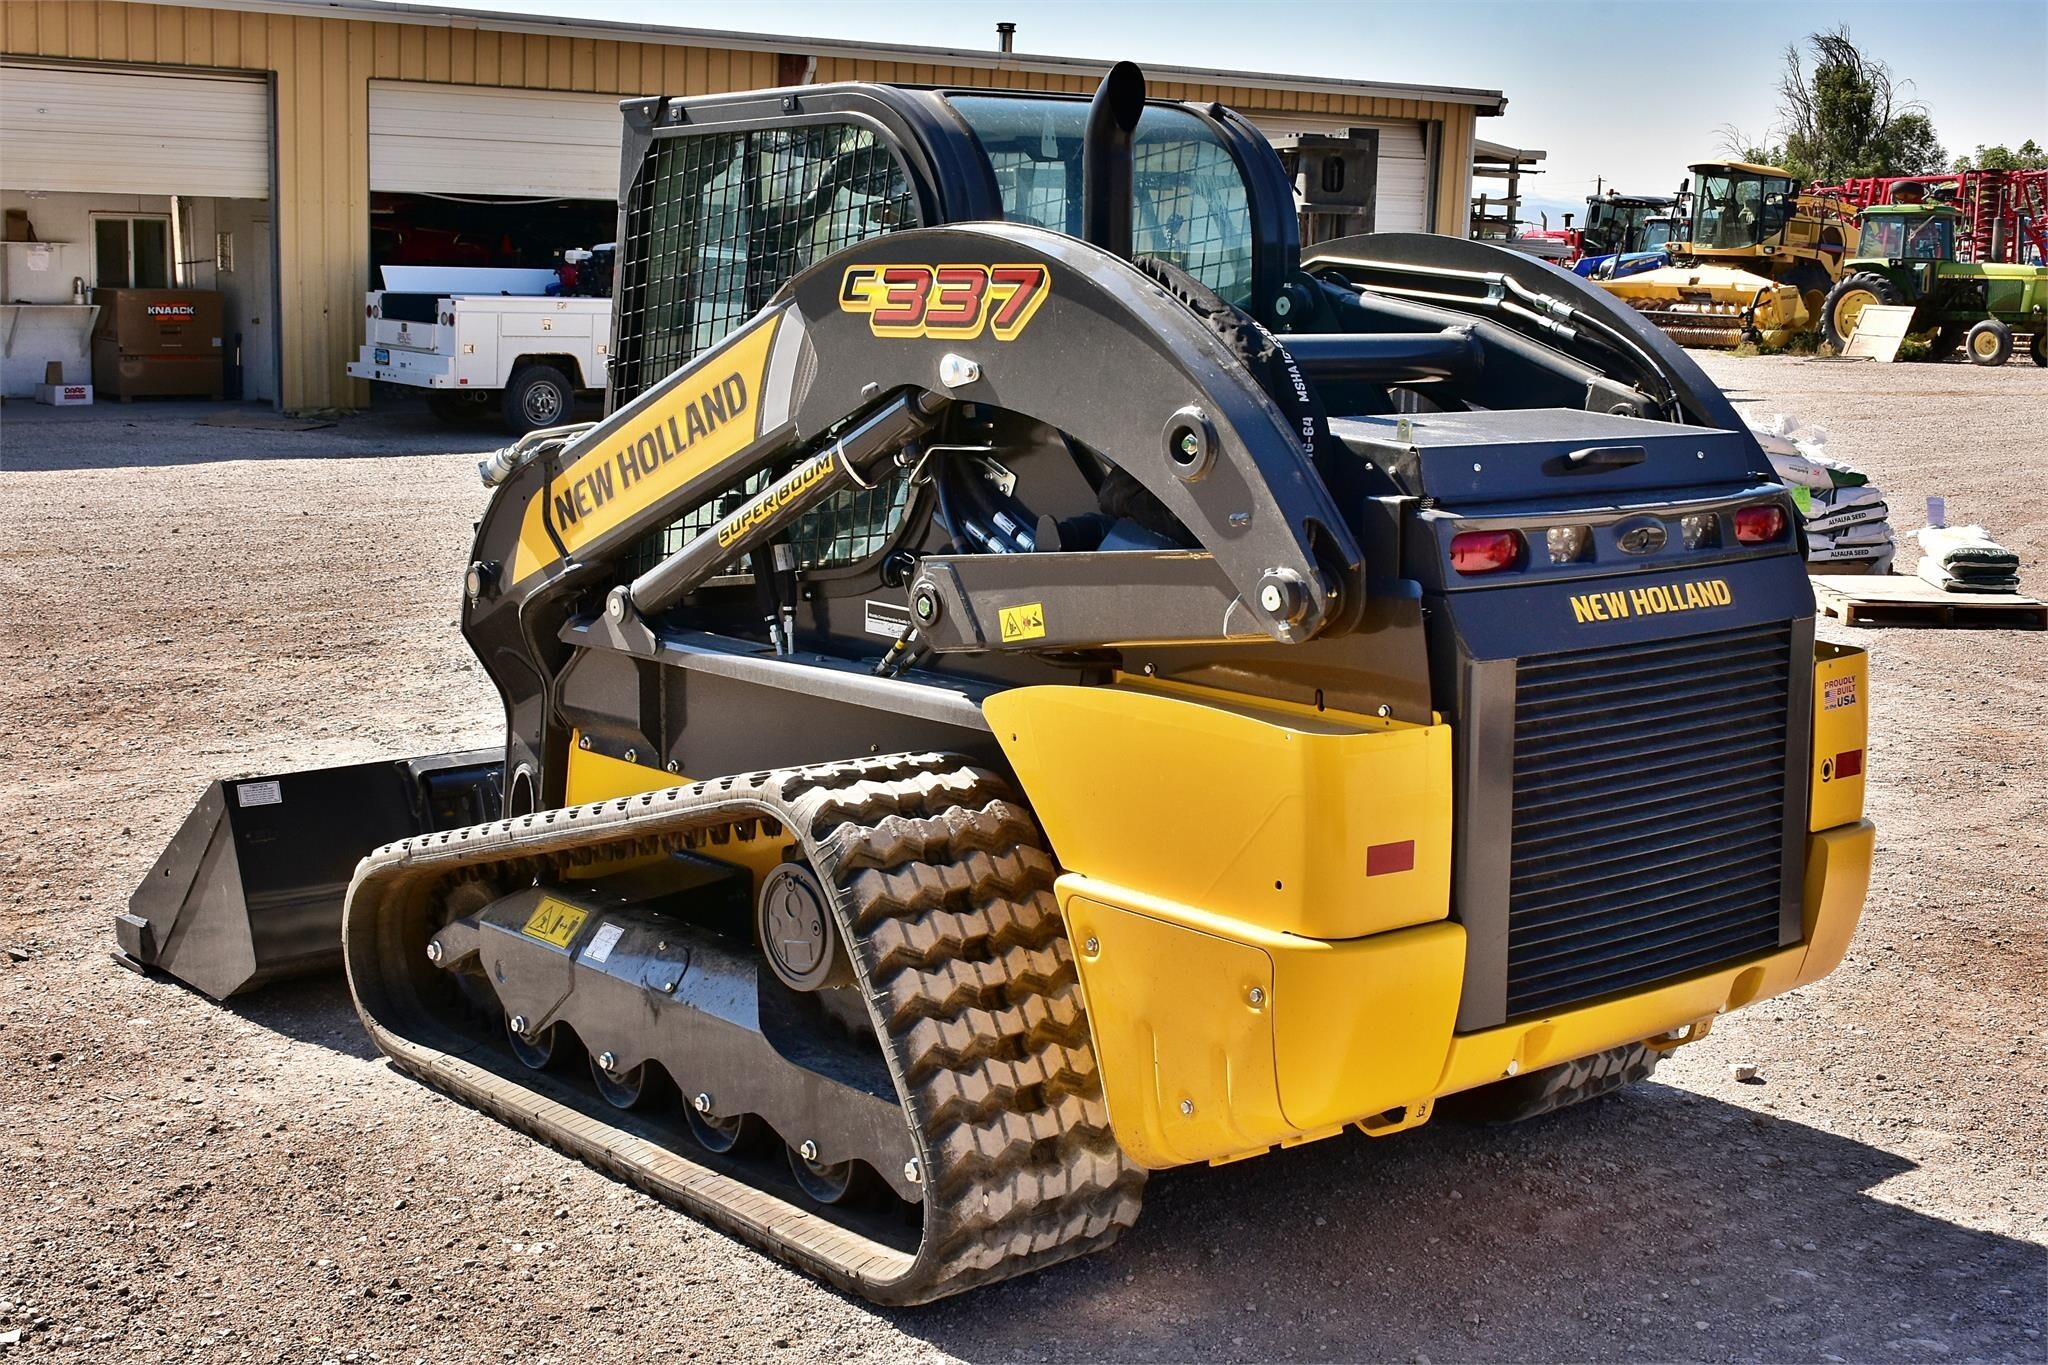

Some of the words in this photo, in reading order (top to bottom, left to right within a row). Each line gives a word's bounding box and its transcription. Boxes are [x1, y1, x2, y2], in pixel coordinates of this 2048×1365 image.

[840, 265, 1048, 335] C337
[147, 306, 194, 315] KNAACK
[1288, 365, 1309, 402] MSHA
[553, 459, 614, 532] NEW
[616, 371, 748, 490] HOLLAND
[719, 494, 778, 545] SUPER
[778, 453, 833, 504] BOOM
[1828, 516, 1851, 526] ALFALFA
[1851, 512, 1867, 521] SEED
[1830, 550, 1853, 558] ALFALFA
[1570, 590, 1629, 623] NEW
[1629, 579, 1732, 616] HOLLAND
[1824, 675, 1856, 689] PROUDLY
[1837, 684, 1856, 696] BUILT
[1837, 694, 1856, 707] USA
